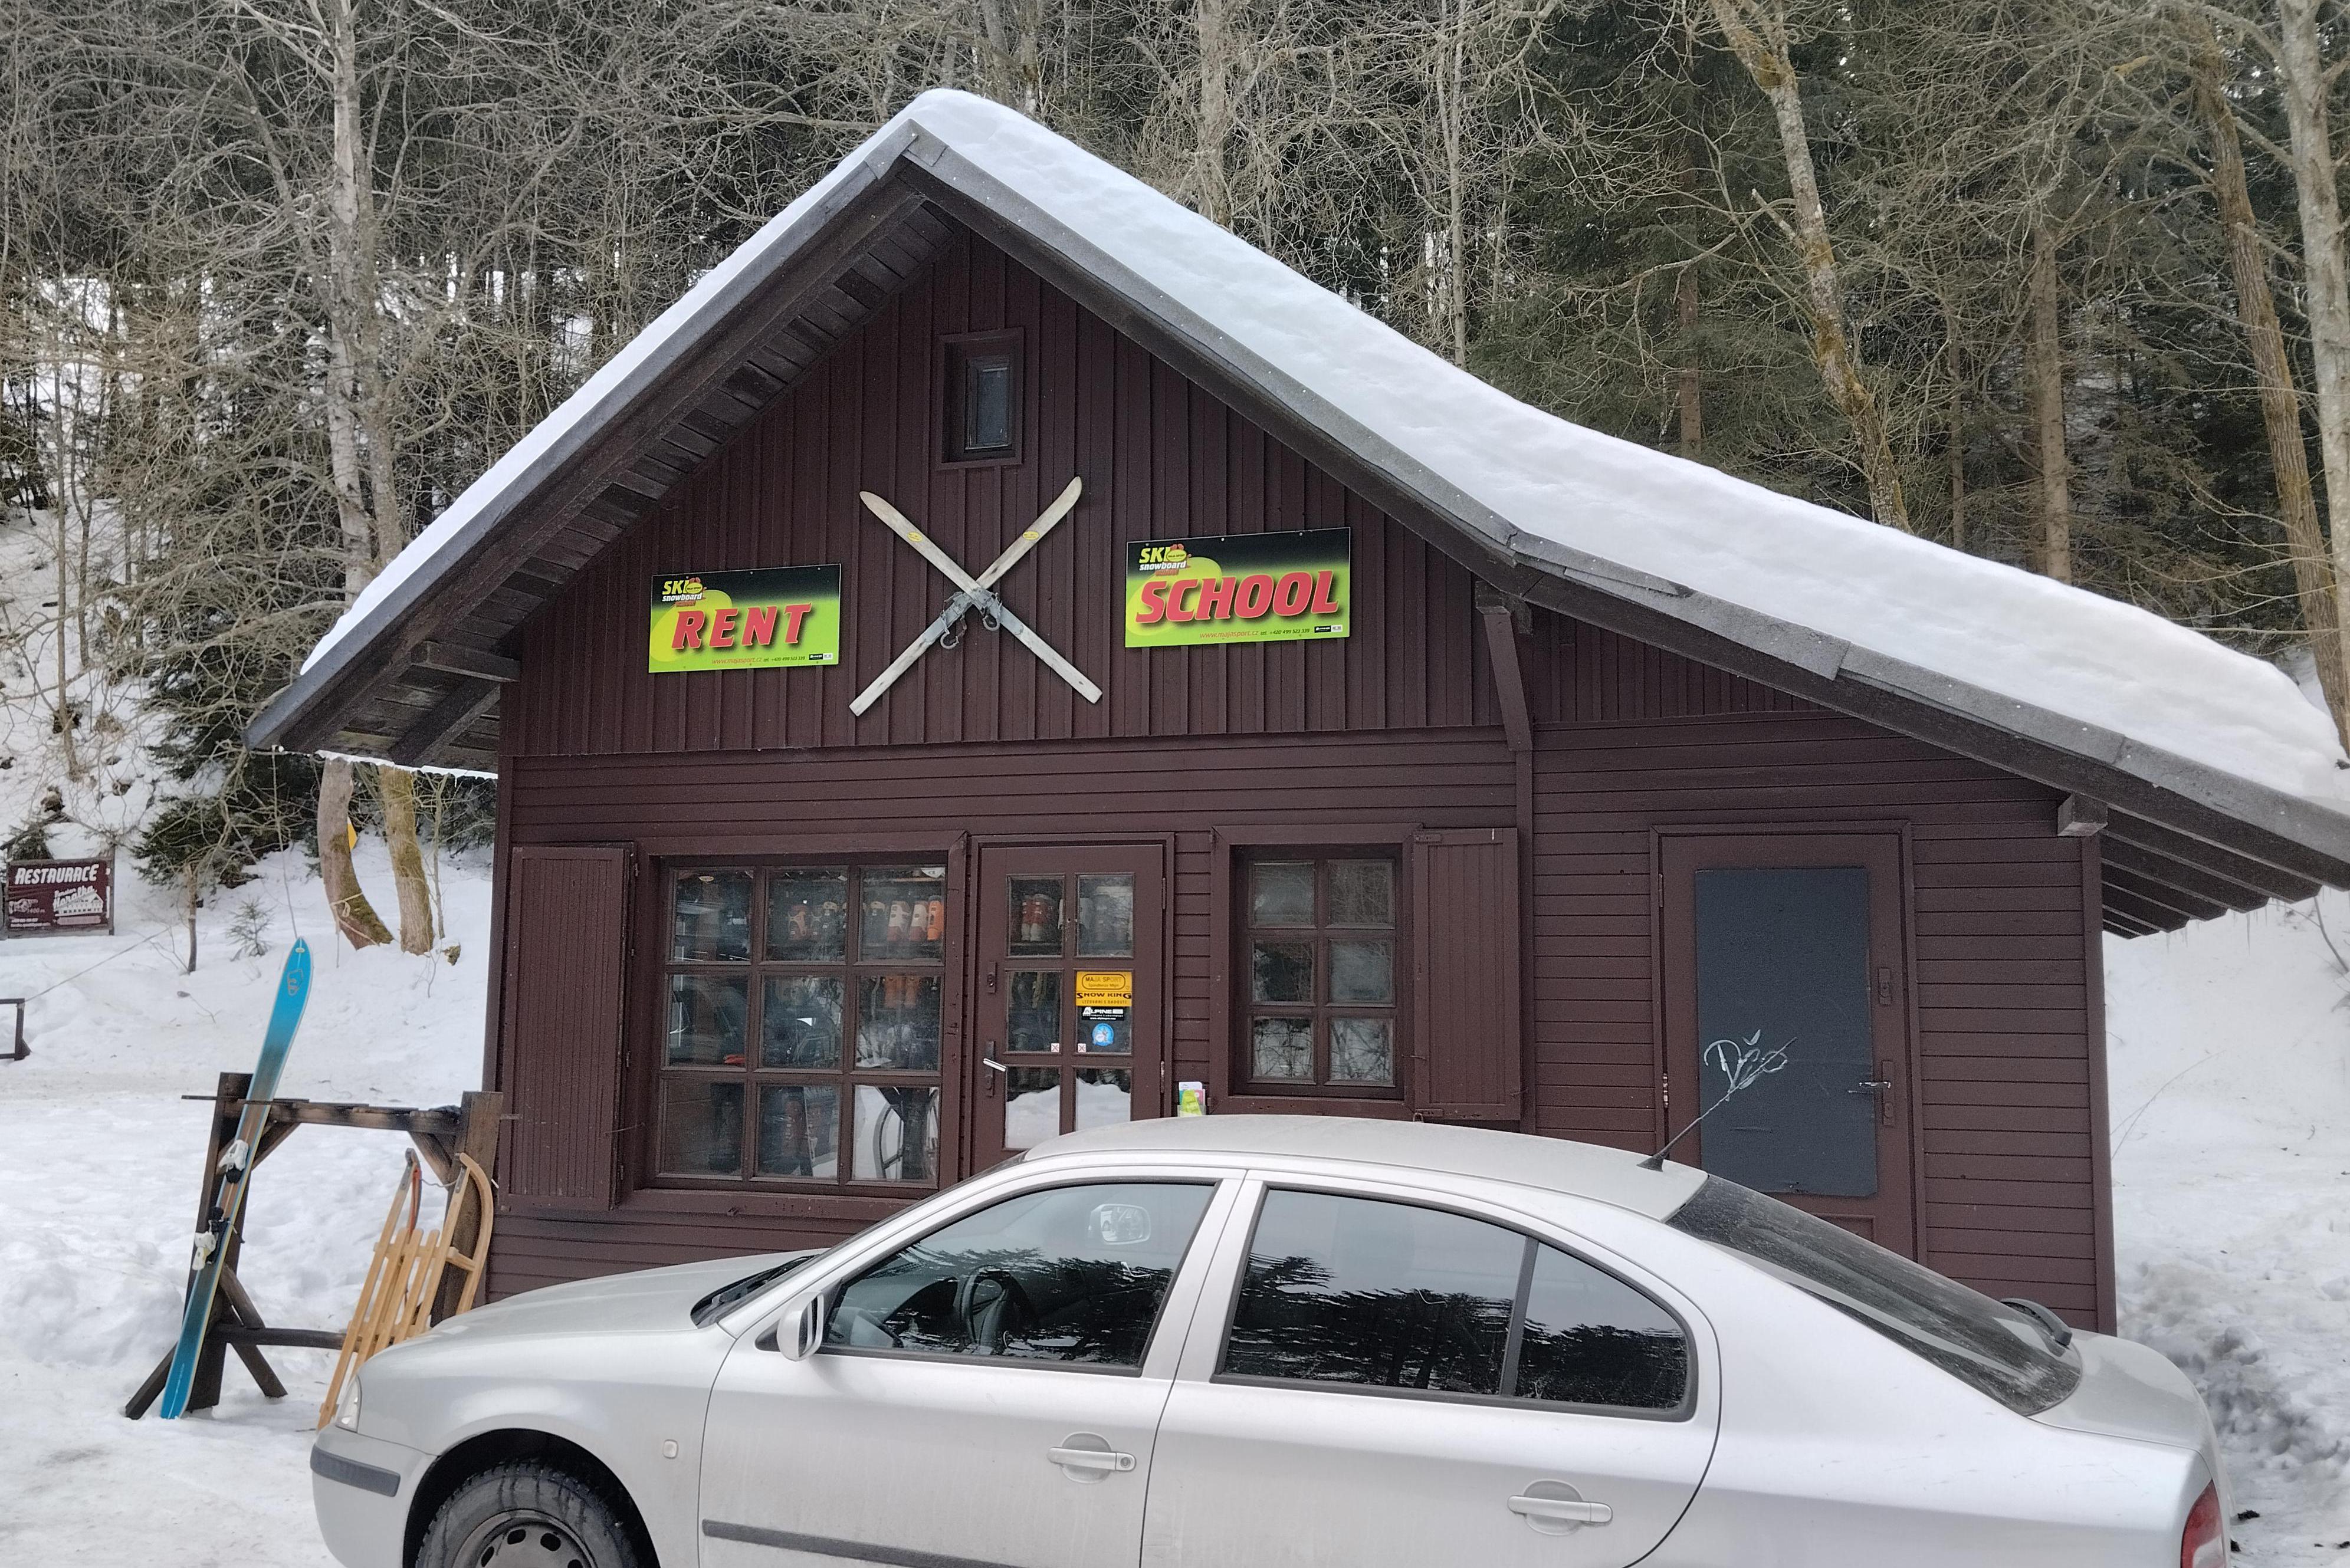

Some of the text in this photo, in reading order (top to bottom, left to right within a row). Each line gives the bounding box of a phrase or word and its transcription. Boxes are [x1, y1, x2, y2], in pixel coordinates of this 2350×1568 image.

[1139, 547, 1171, 564] SKI
[1139, 560, 1187, 571] snowboard
[662, 580, 690, 595] SKI
[662, 593, 703, 601] snowboard
[1135, 570, 1339, 623] SCHOOL
[671, 601, 812, 649] RENT
[1199, 630, 1259, 639] www.majasport.cz
[15, 864, 99, 885] RESTAURACE
